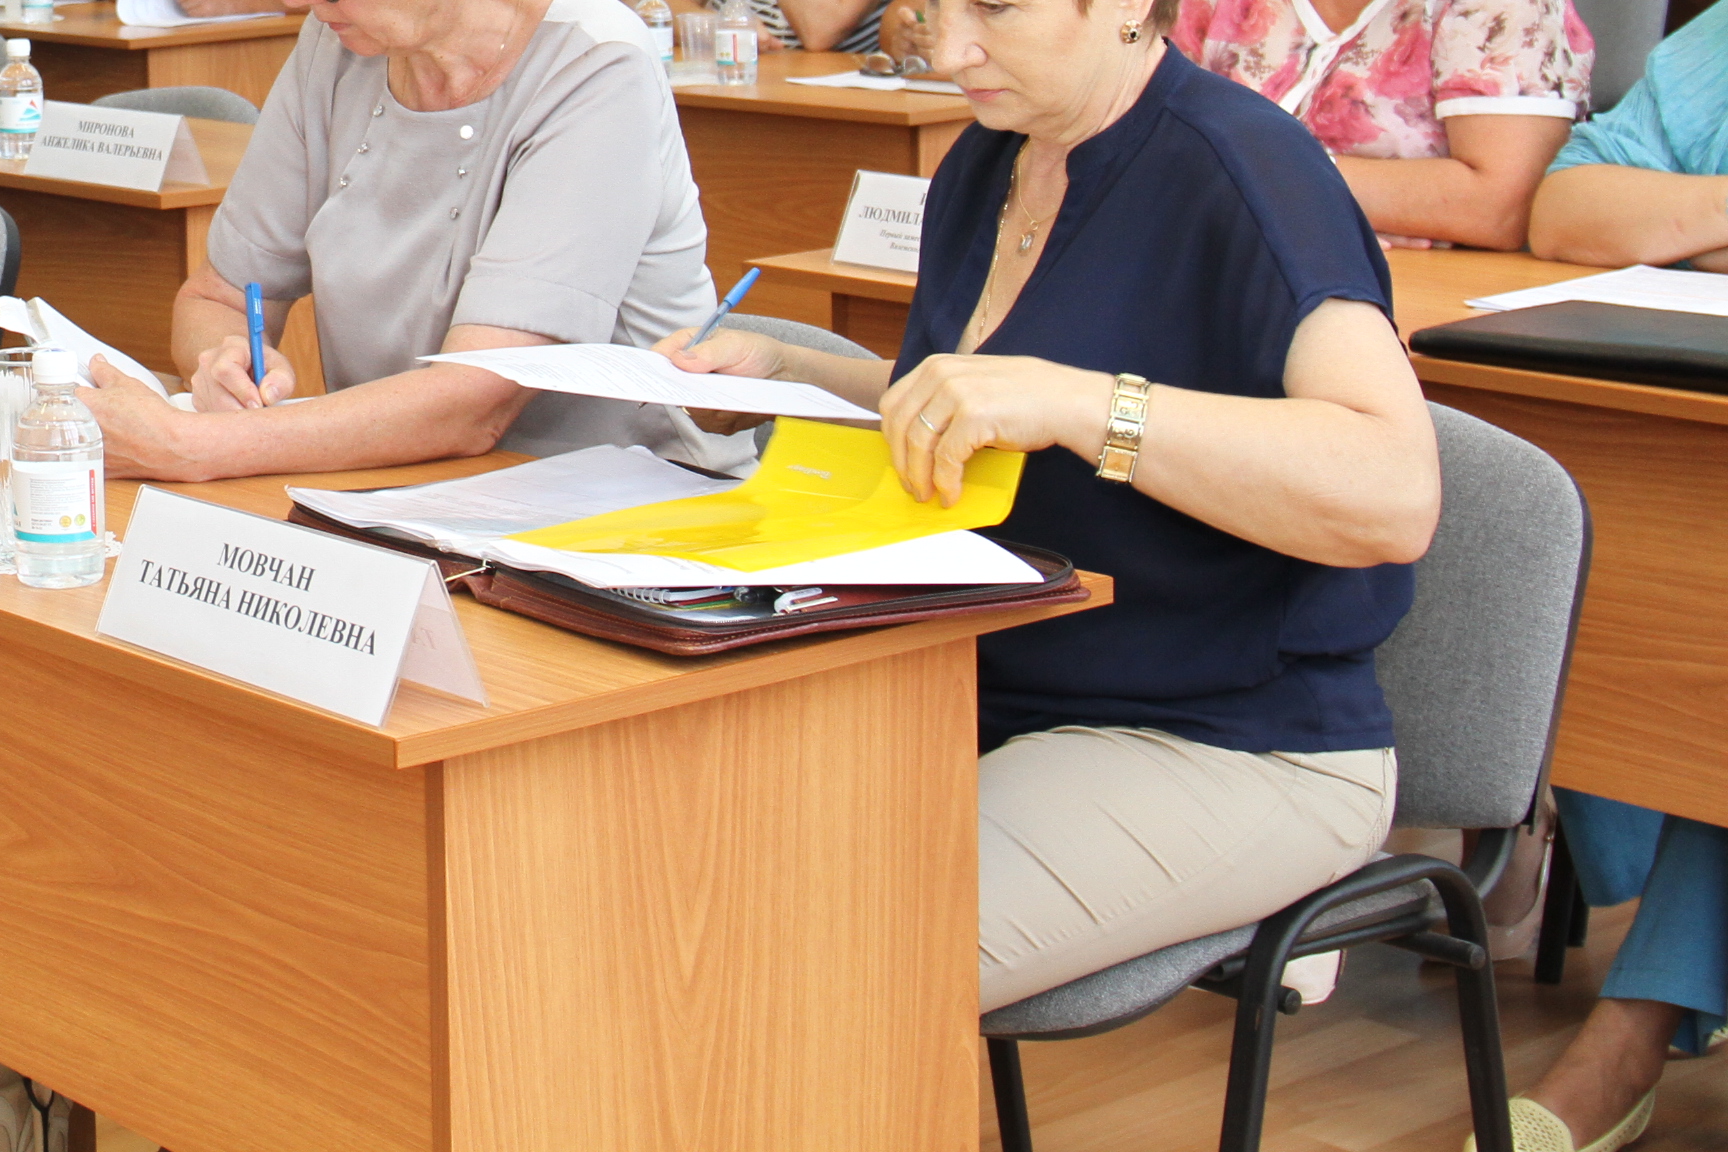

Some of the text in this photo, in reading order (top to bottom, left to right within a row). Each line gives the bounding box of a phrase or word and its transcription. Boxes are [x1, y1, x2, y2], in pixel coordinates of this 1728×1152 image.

[41, 135, 163, 162] АНЖЕЛИКА ВАЛЕРЬЕВНА
[78, 120, 134, 139] МИРОНОВА
[217, 542, 316, 593] МОВЧАН
[138, 559, 377, 656] ТАТЬЯНА НИКОЛЕВНА
